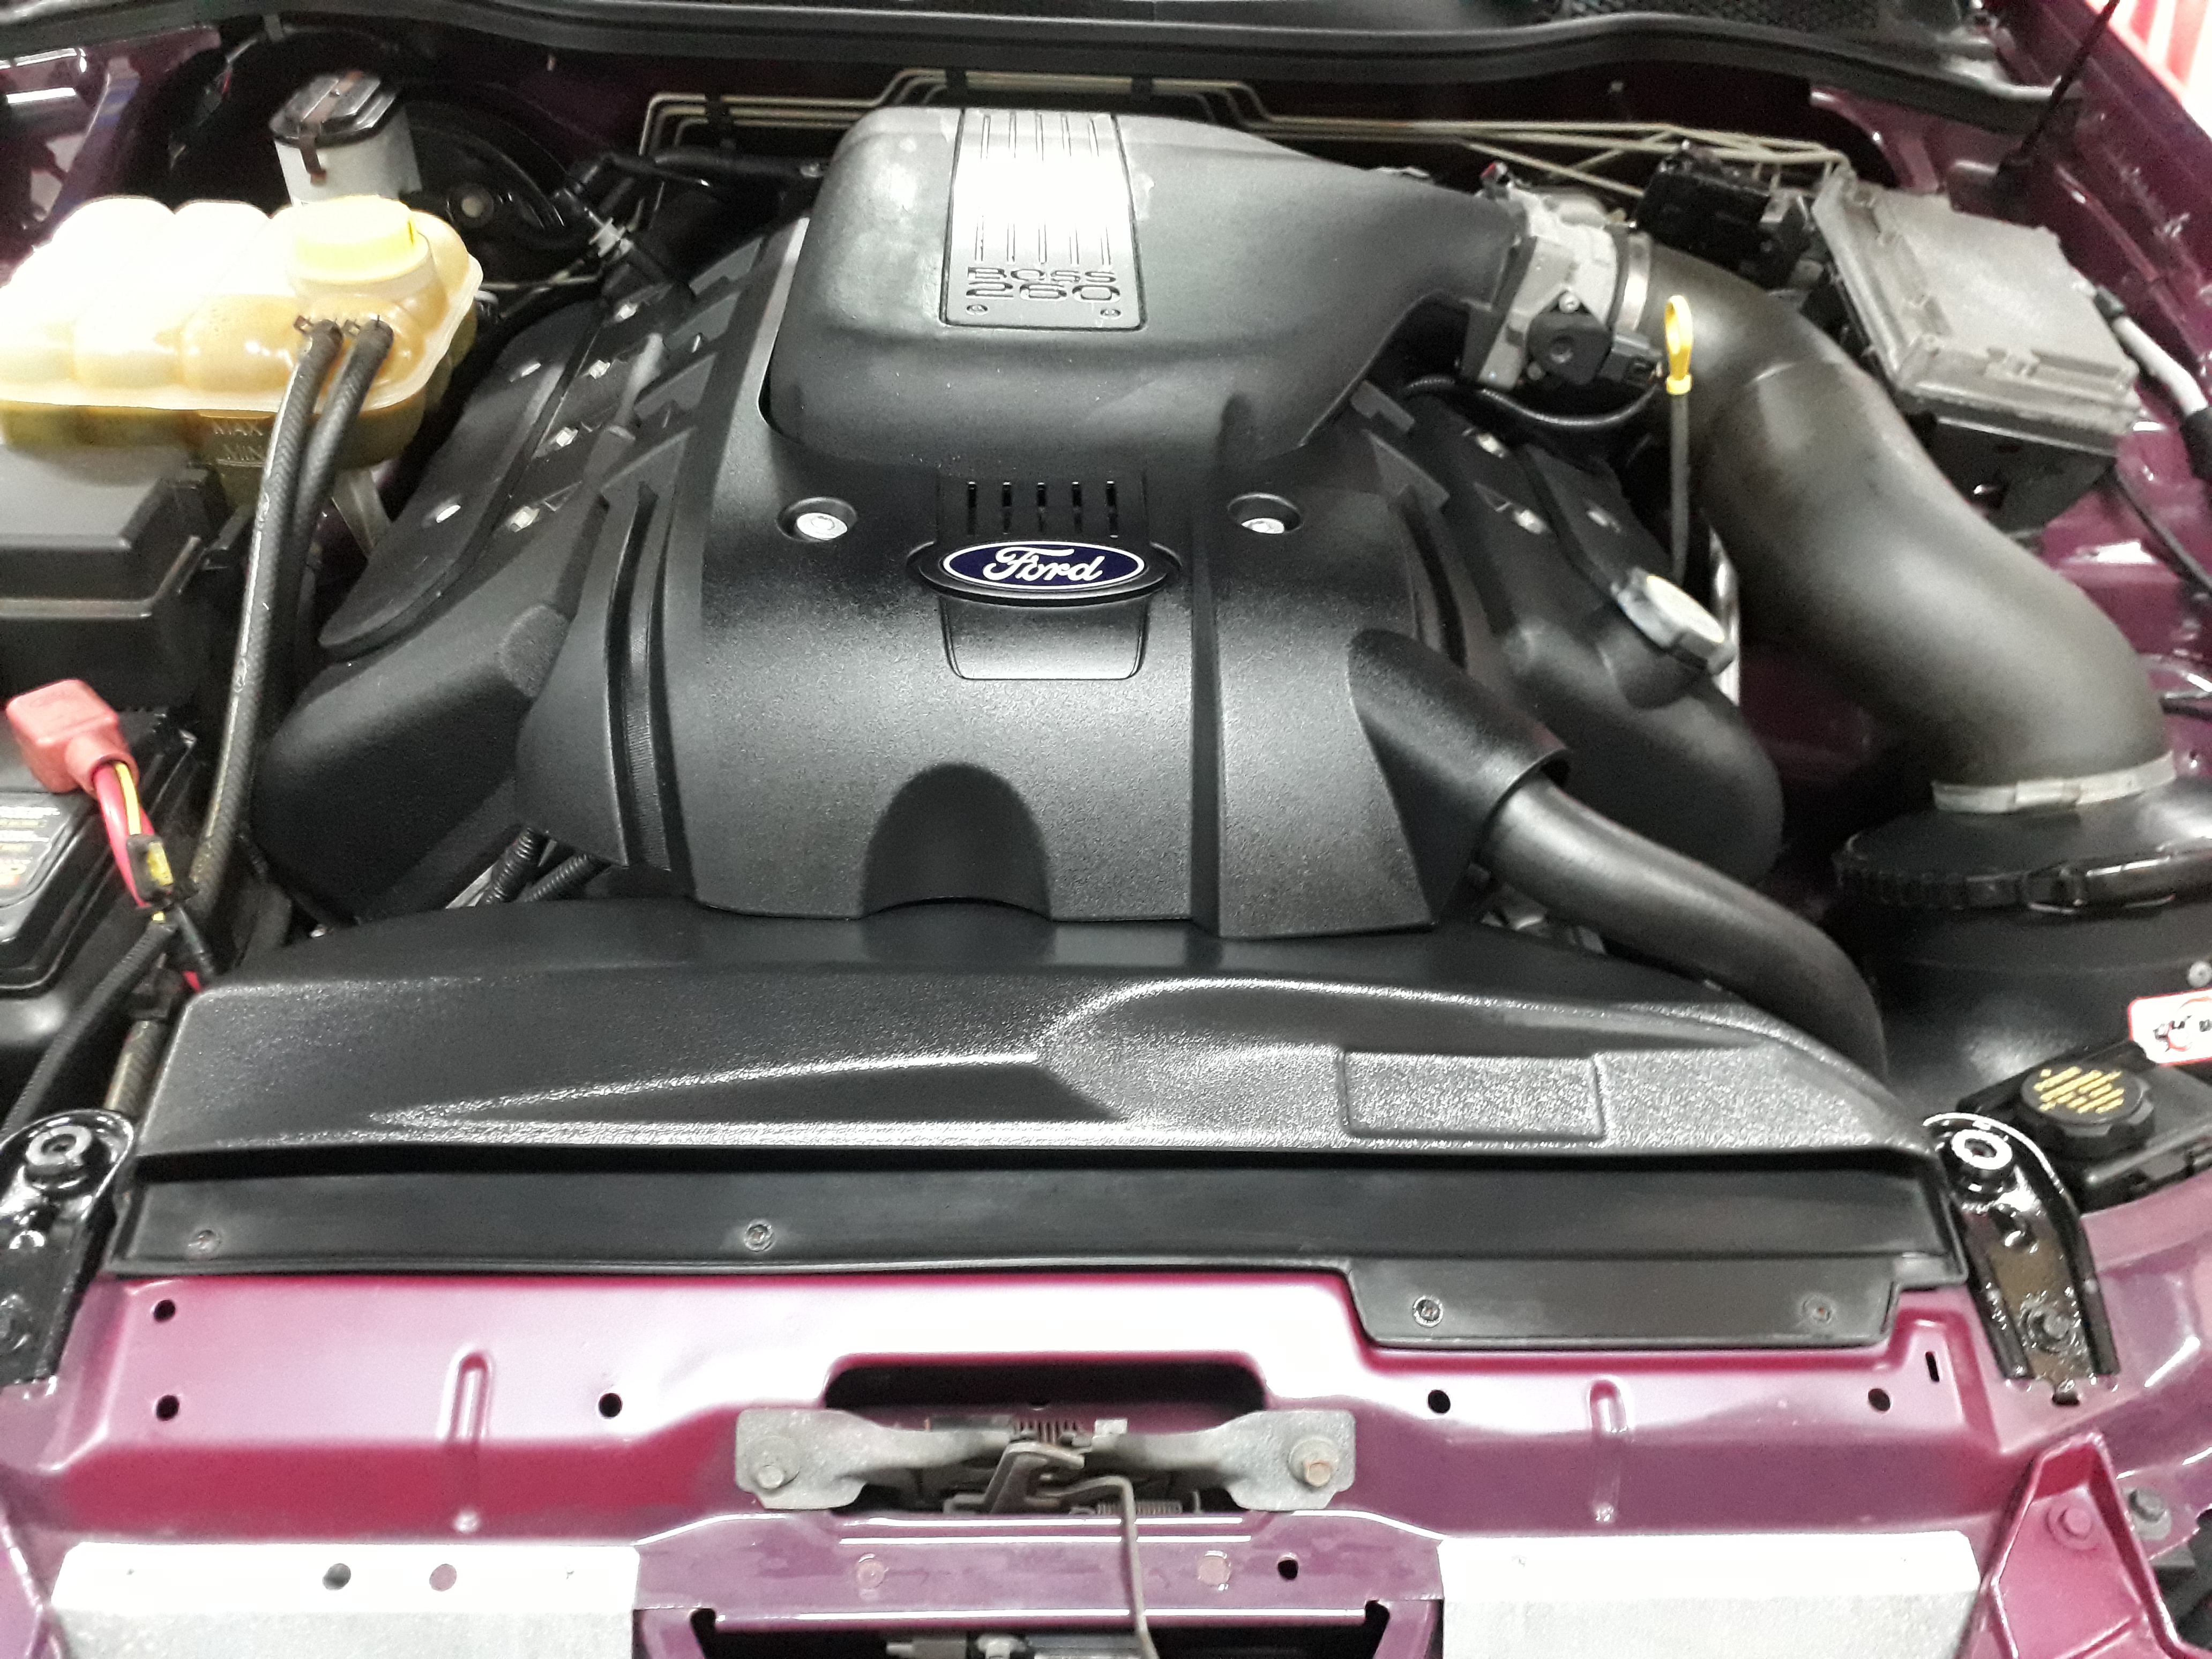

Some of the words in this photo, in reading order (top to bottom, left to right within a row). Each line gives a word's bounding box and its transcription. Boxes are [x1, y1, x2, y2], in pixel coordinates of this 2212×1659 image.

[967, 266, 1116, 285] BOSS
[965, 282, 1121, 303] 260
[982, 547, 1105, 581] Ford
